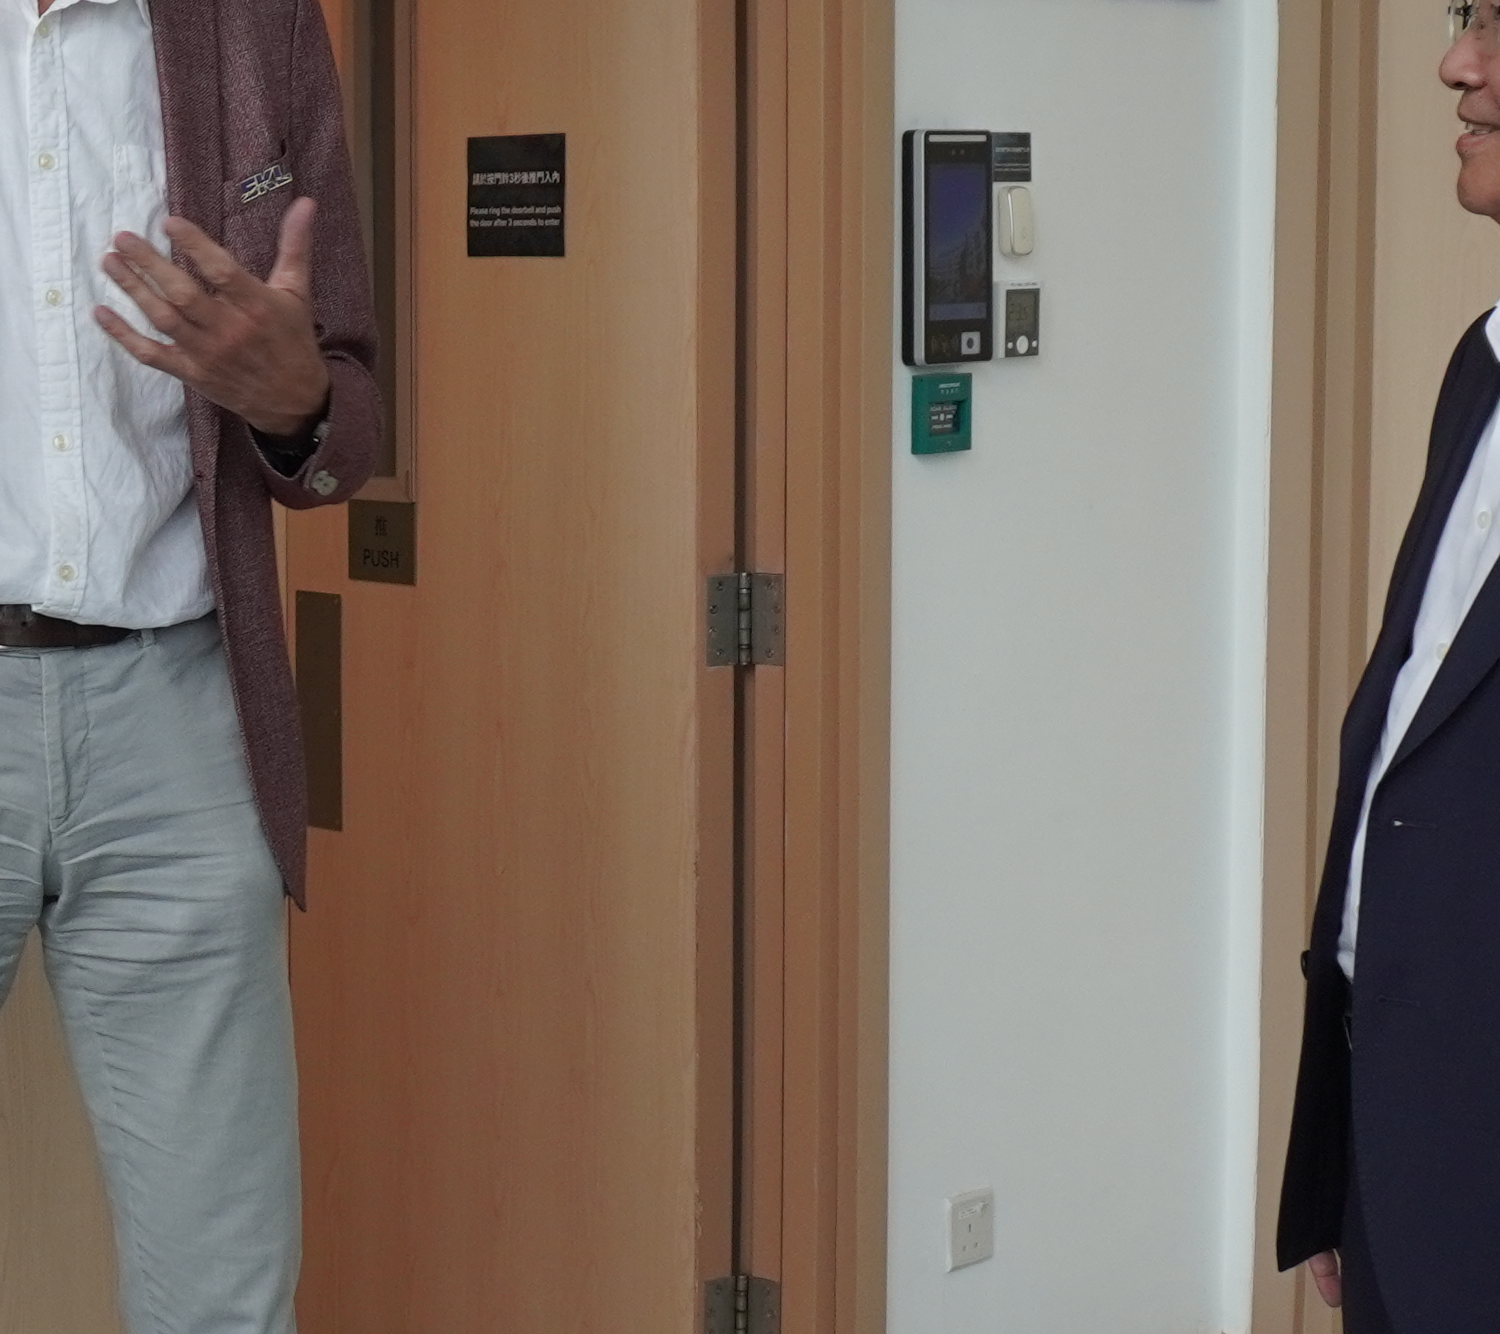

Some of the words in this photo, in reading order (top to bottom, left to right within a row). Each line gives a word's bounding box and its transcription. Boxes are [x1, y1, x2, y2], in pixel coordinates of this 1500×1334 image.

[470, 206, 488, 215] Please
[489, 206, 500, 216] ring
[501, 206, 510, 214] the
[511, 206, 534, 214] doorbell
[535, 205, 546, 214] and
[547, 205, 561, 215] push
[469, 219, 479, 227] the
[480, 219, 493, 227] door
[493, 218, 507, 227] after
[513, 218, 537, 226] seconds
[538, 218, 544, 226] to
[545, 218, 560, 226] enter
[363, 548, 399, 568] PUSH
